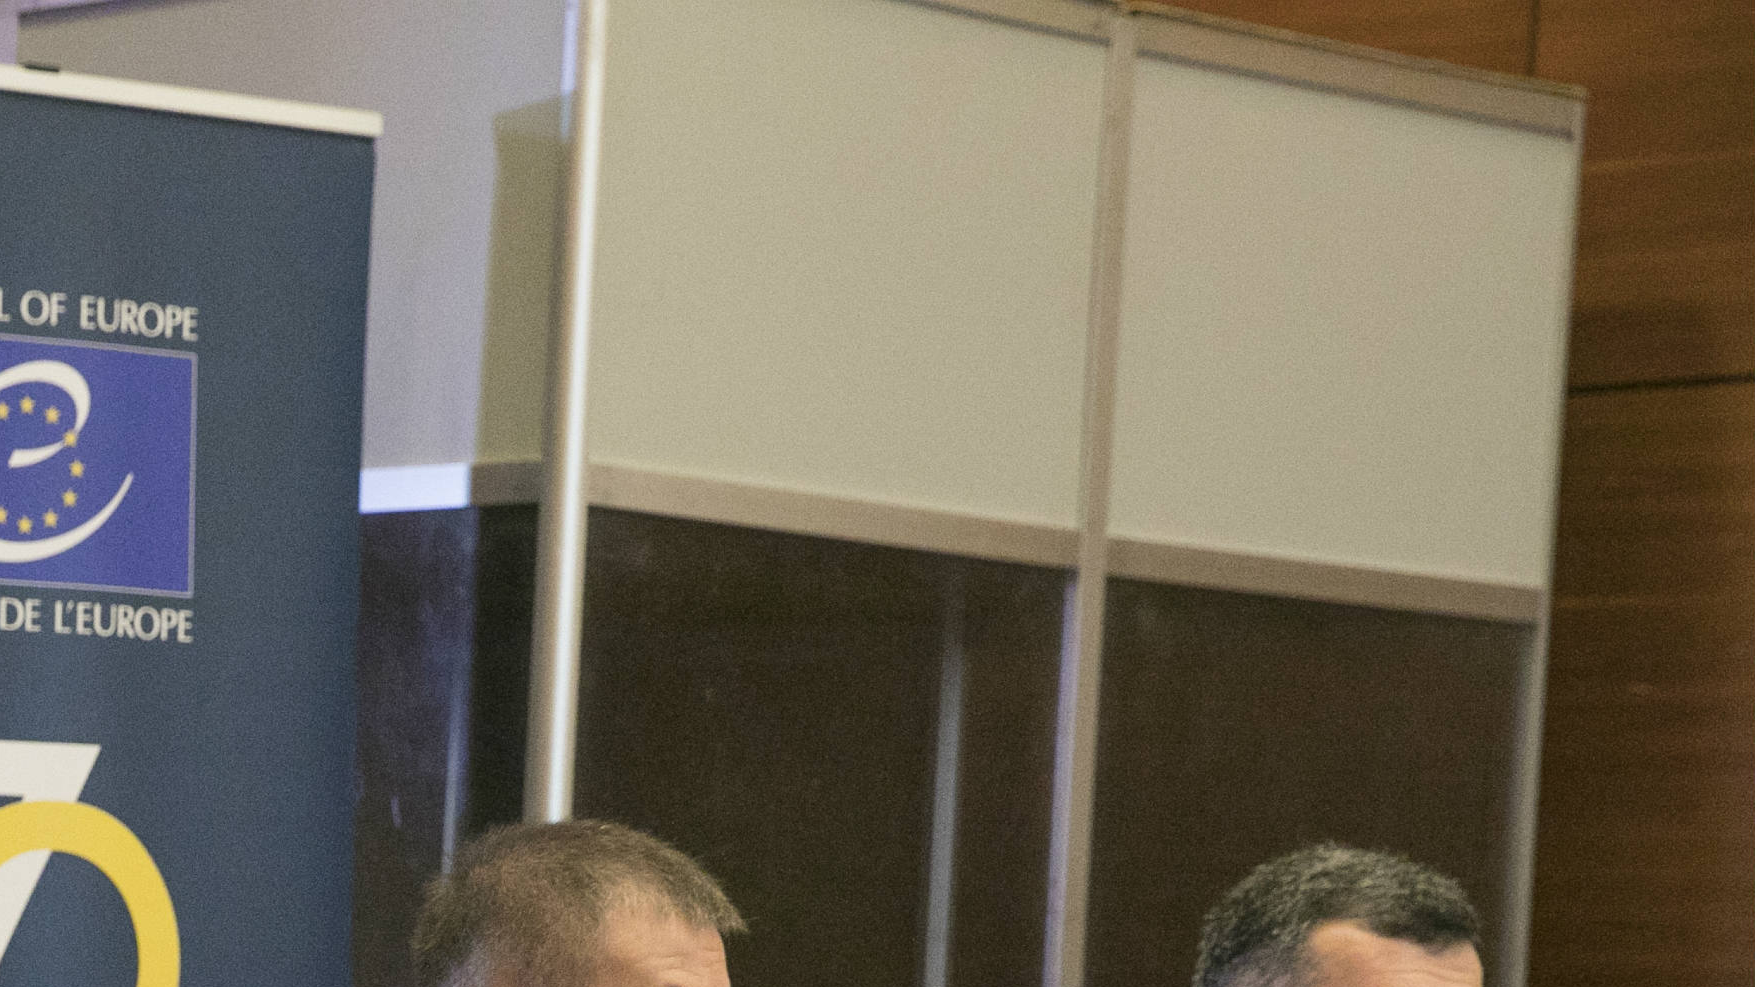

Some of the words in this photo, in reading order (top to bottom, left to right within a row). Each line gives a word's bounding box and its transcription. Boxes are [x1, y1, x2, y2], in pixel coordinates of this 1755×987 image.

[20, 290, 67, 326] OF
[80, 296, 198, 341] EUROPE
[0, 597, 42, 632] DE
